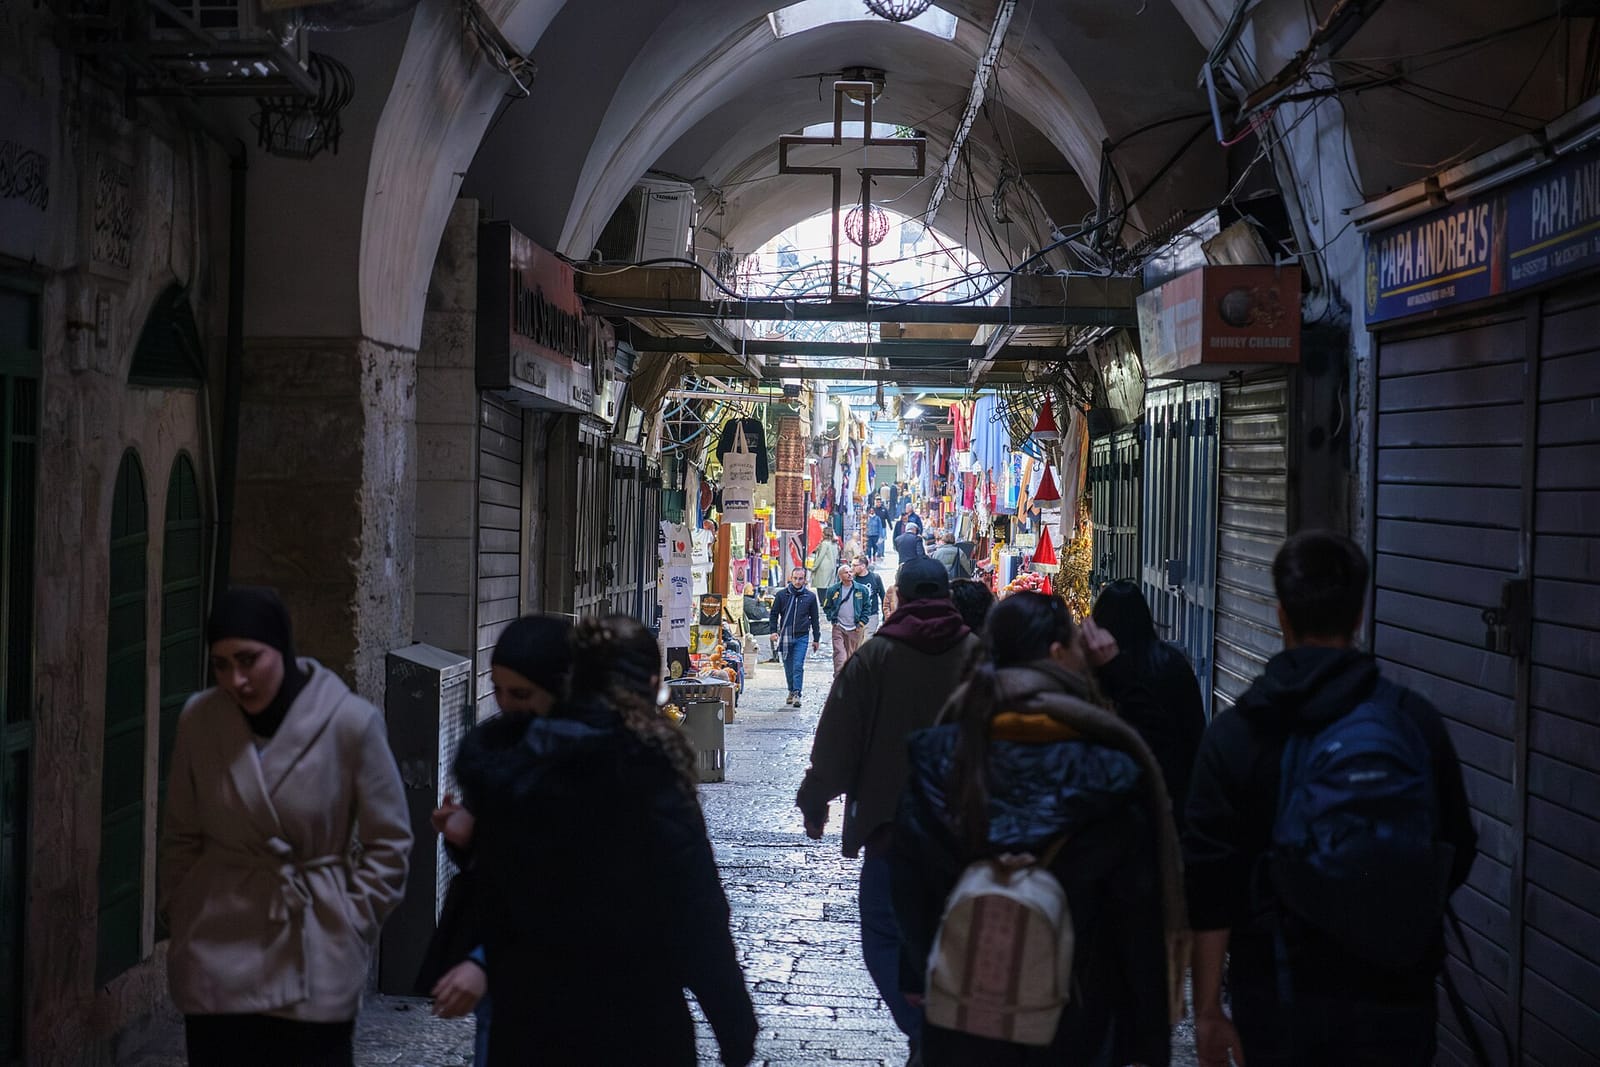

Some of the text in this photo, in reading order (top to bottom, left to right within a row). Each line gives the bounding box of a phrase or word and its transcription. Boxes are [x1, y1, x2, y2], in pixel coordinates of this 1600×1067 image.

[1531, 176, 1569, 241] PAPA
[1380, 231, 1413, 289] PAPA
[1415, 203, 1489, 279] ANDREA'S
[1210, 336, 1247, 348] MONEY
